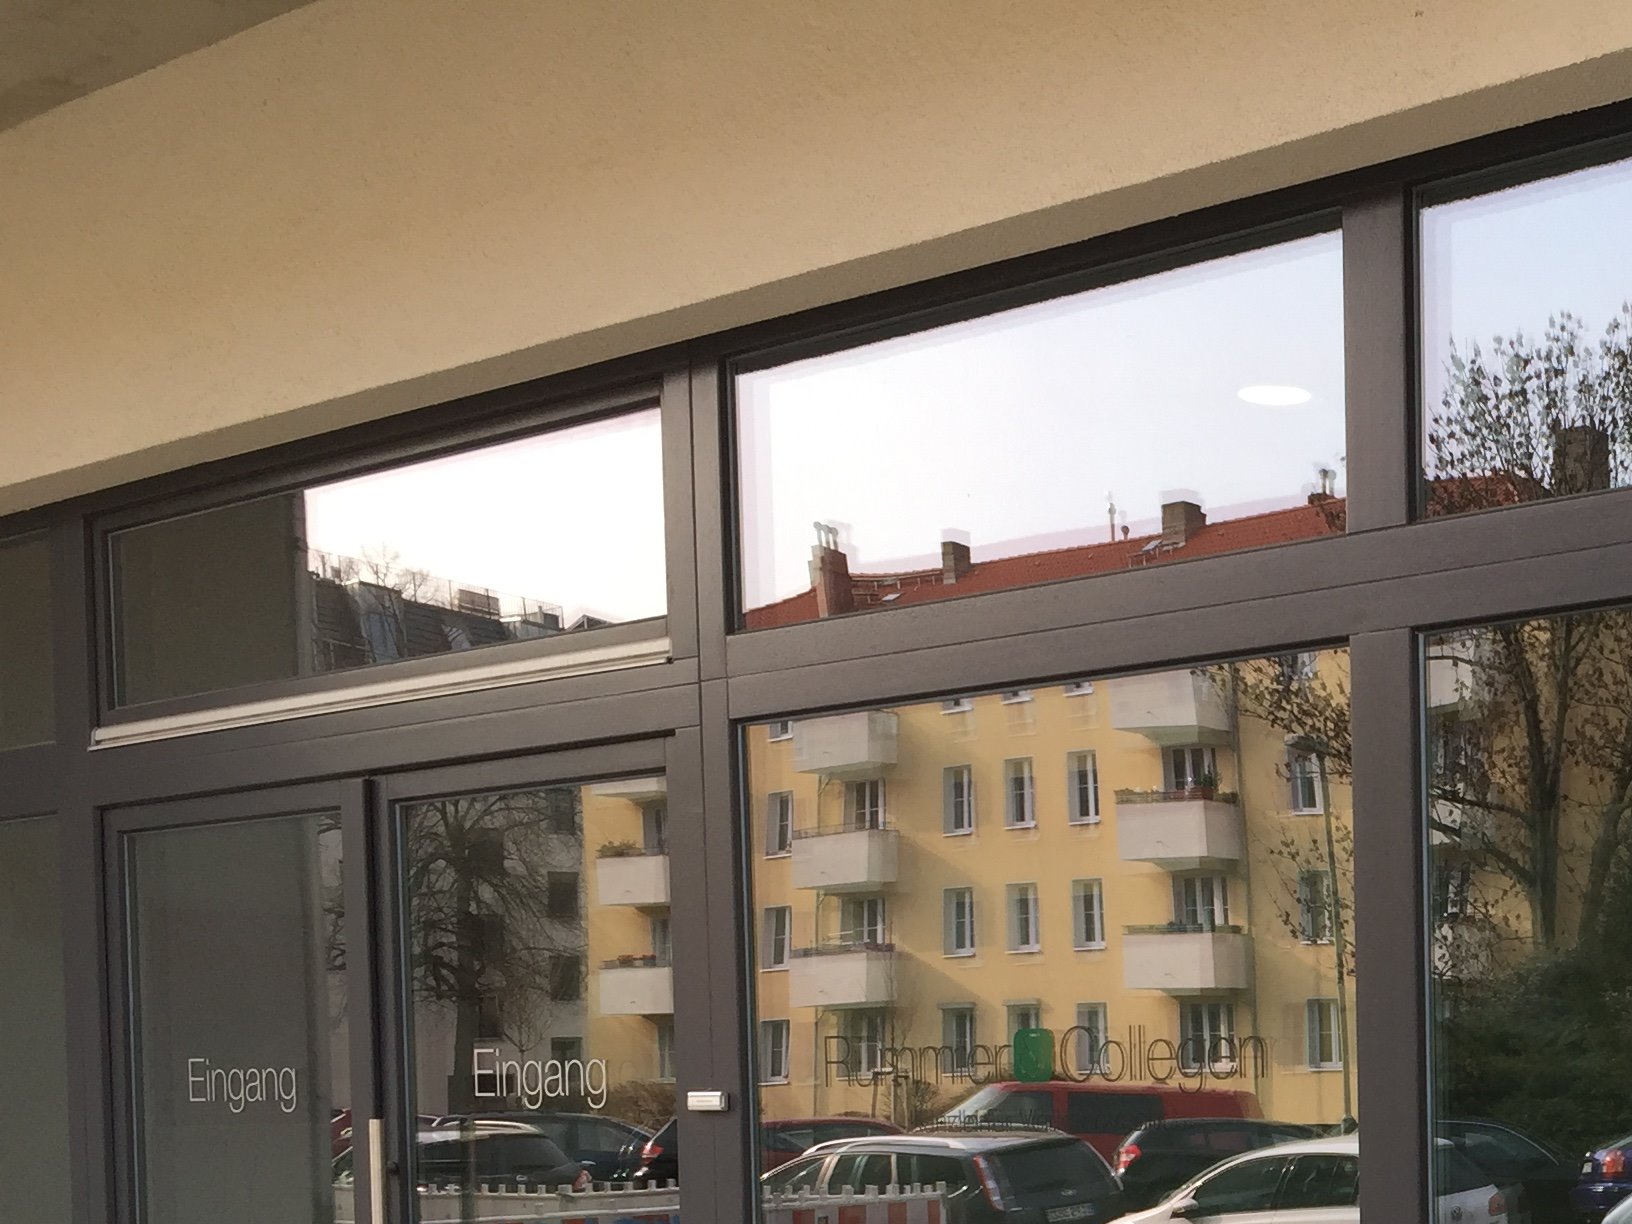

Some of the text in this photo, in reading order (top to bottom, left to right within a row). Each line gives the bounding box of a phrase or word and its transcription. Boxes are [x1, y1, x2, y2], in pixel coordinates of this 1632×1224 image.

[187, 1058, 297, 1113] Eingang
[473, 1048, 607, 1109] Eingang
[824, 1034, 1013, 1088] Rmmer
[1060, 1025, 1268, 1094] Collegen
